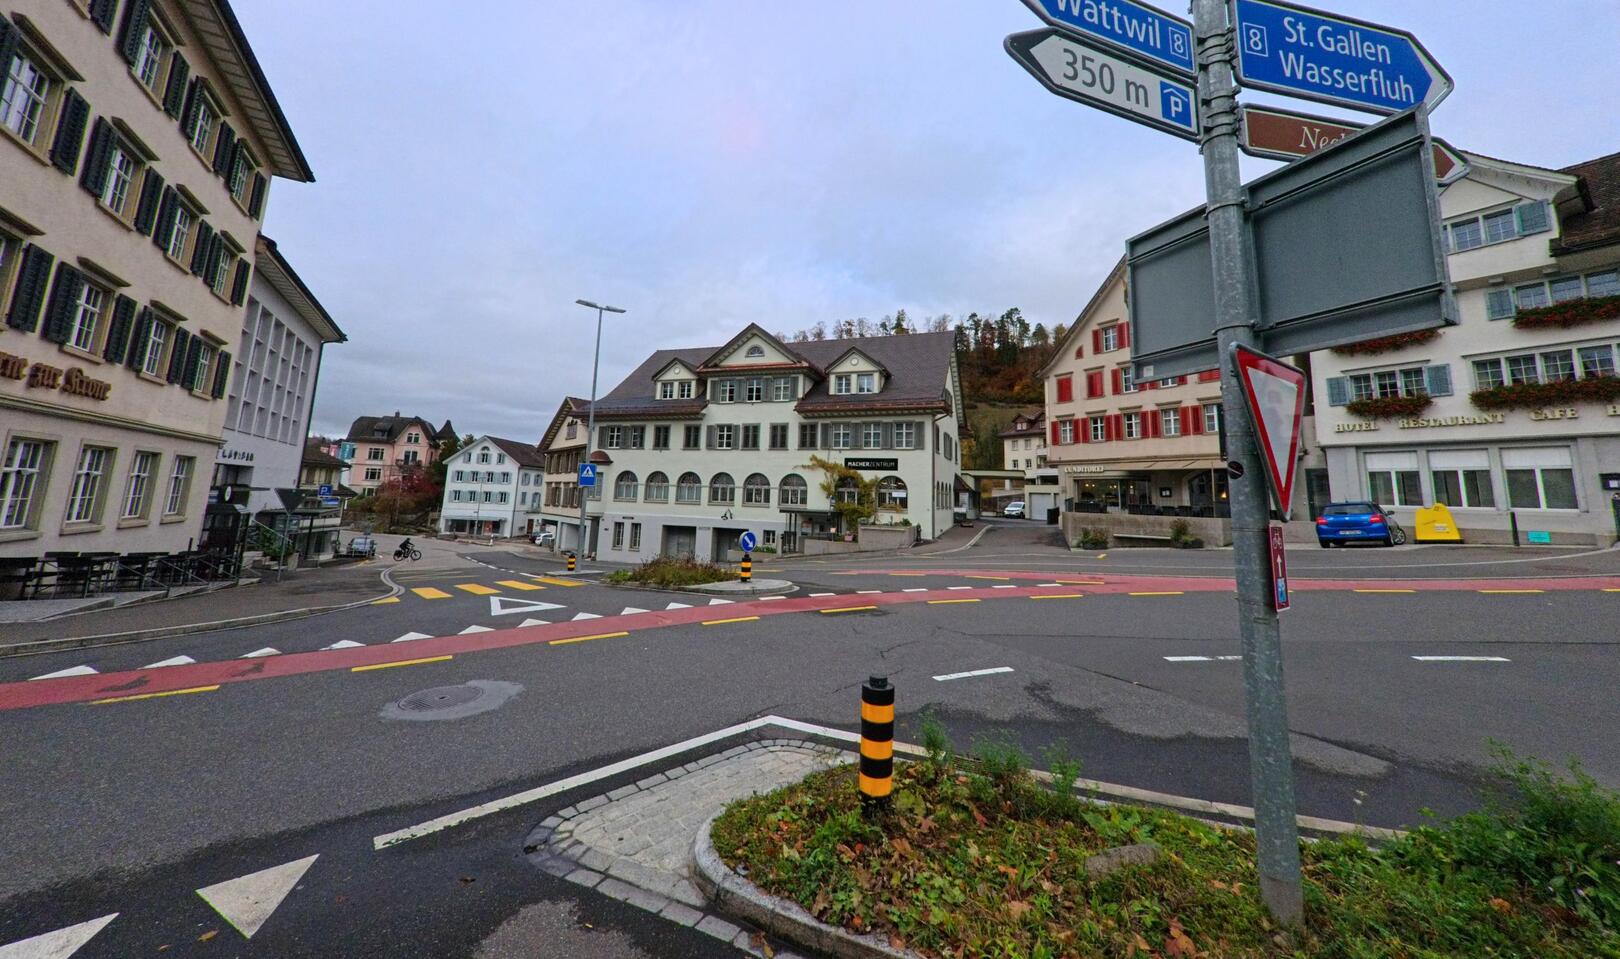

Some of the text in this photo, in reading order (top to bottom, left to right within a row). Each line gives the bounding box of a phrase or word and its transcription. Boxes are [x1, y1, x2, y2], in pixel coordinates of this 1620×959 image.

[1055, 0, 1185, 54] Wattwil 8
[1249, 28, 1263, 51] 8
[1063, 48, 1149, 108] 350 m
[1279, 50, 1415, 104] Wasserfluh
[28, 362, 64, 389] zur
[63, 366, 112, 401] Krone
[1335, 420, 1378, 433] HOTEL
[1399, 412, 1505, 429] RESTAURANT
